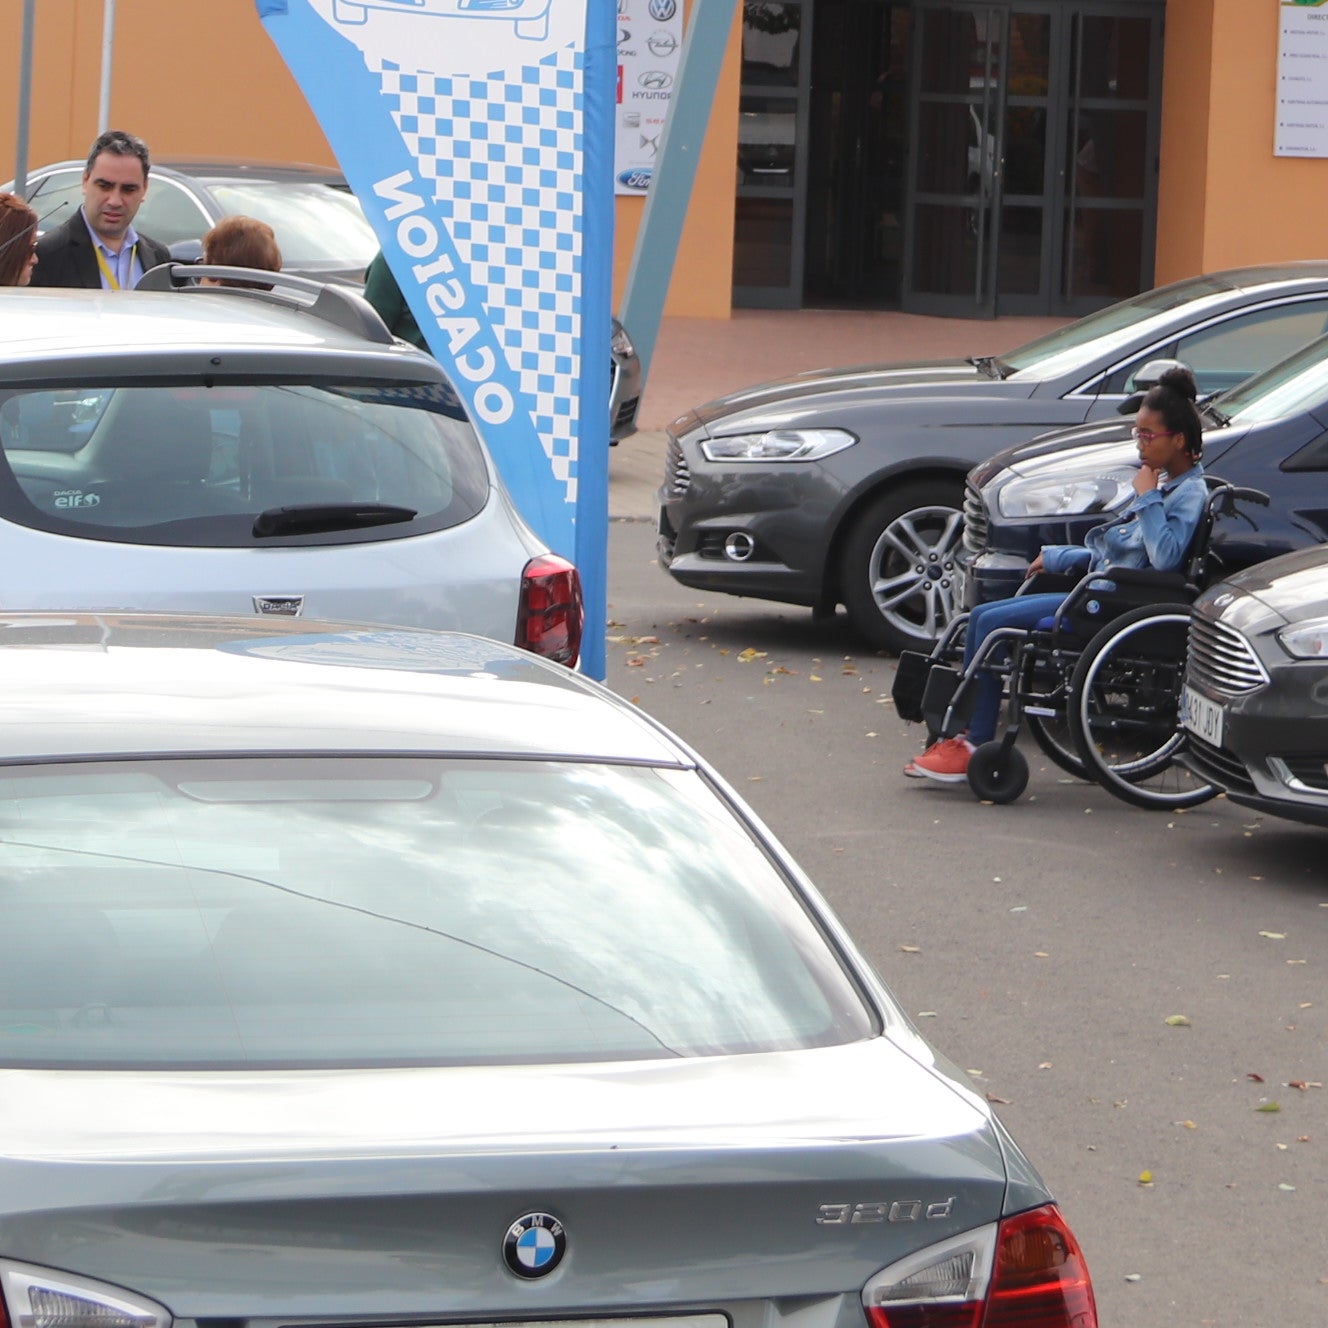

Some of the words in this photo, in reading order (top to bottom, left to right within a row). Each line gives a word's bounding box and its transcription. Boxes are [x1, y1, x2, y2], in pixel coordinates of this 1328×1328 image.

[55, 495, 83, 507] elf
[815, 1195, 958, 1225] 320d
[511, 1215, 563, 1238] BMW
